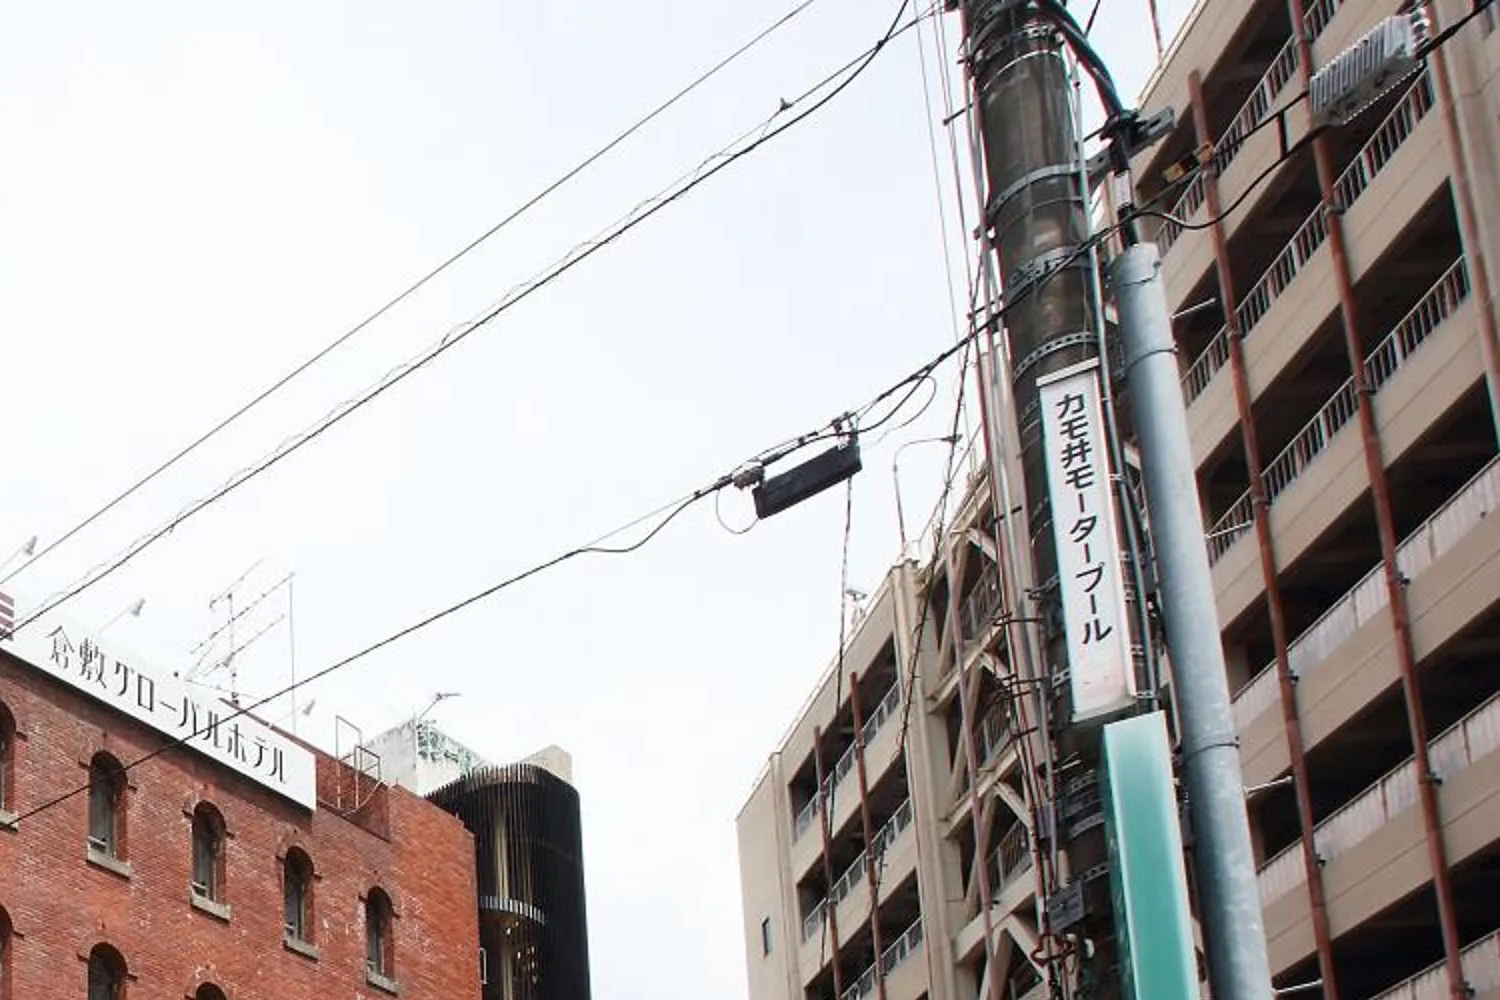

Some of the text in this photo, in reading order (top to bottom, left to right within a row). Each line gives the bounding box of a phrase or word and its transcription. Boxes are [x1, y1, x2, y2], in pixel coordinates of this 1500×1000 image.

[1056, 393, 1112, 645] カモ井モータープール
[44, 625, 286, 784] 倉敷グローバルホテル
